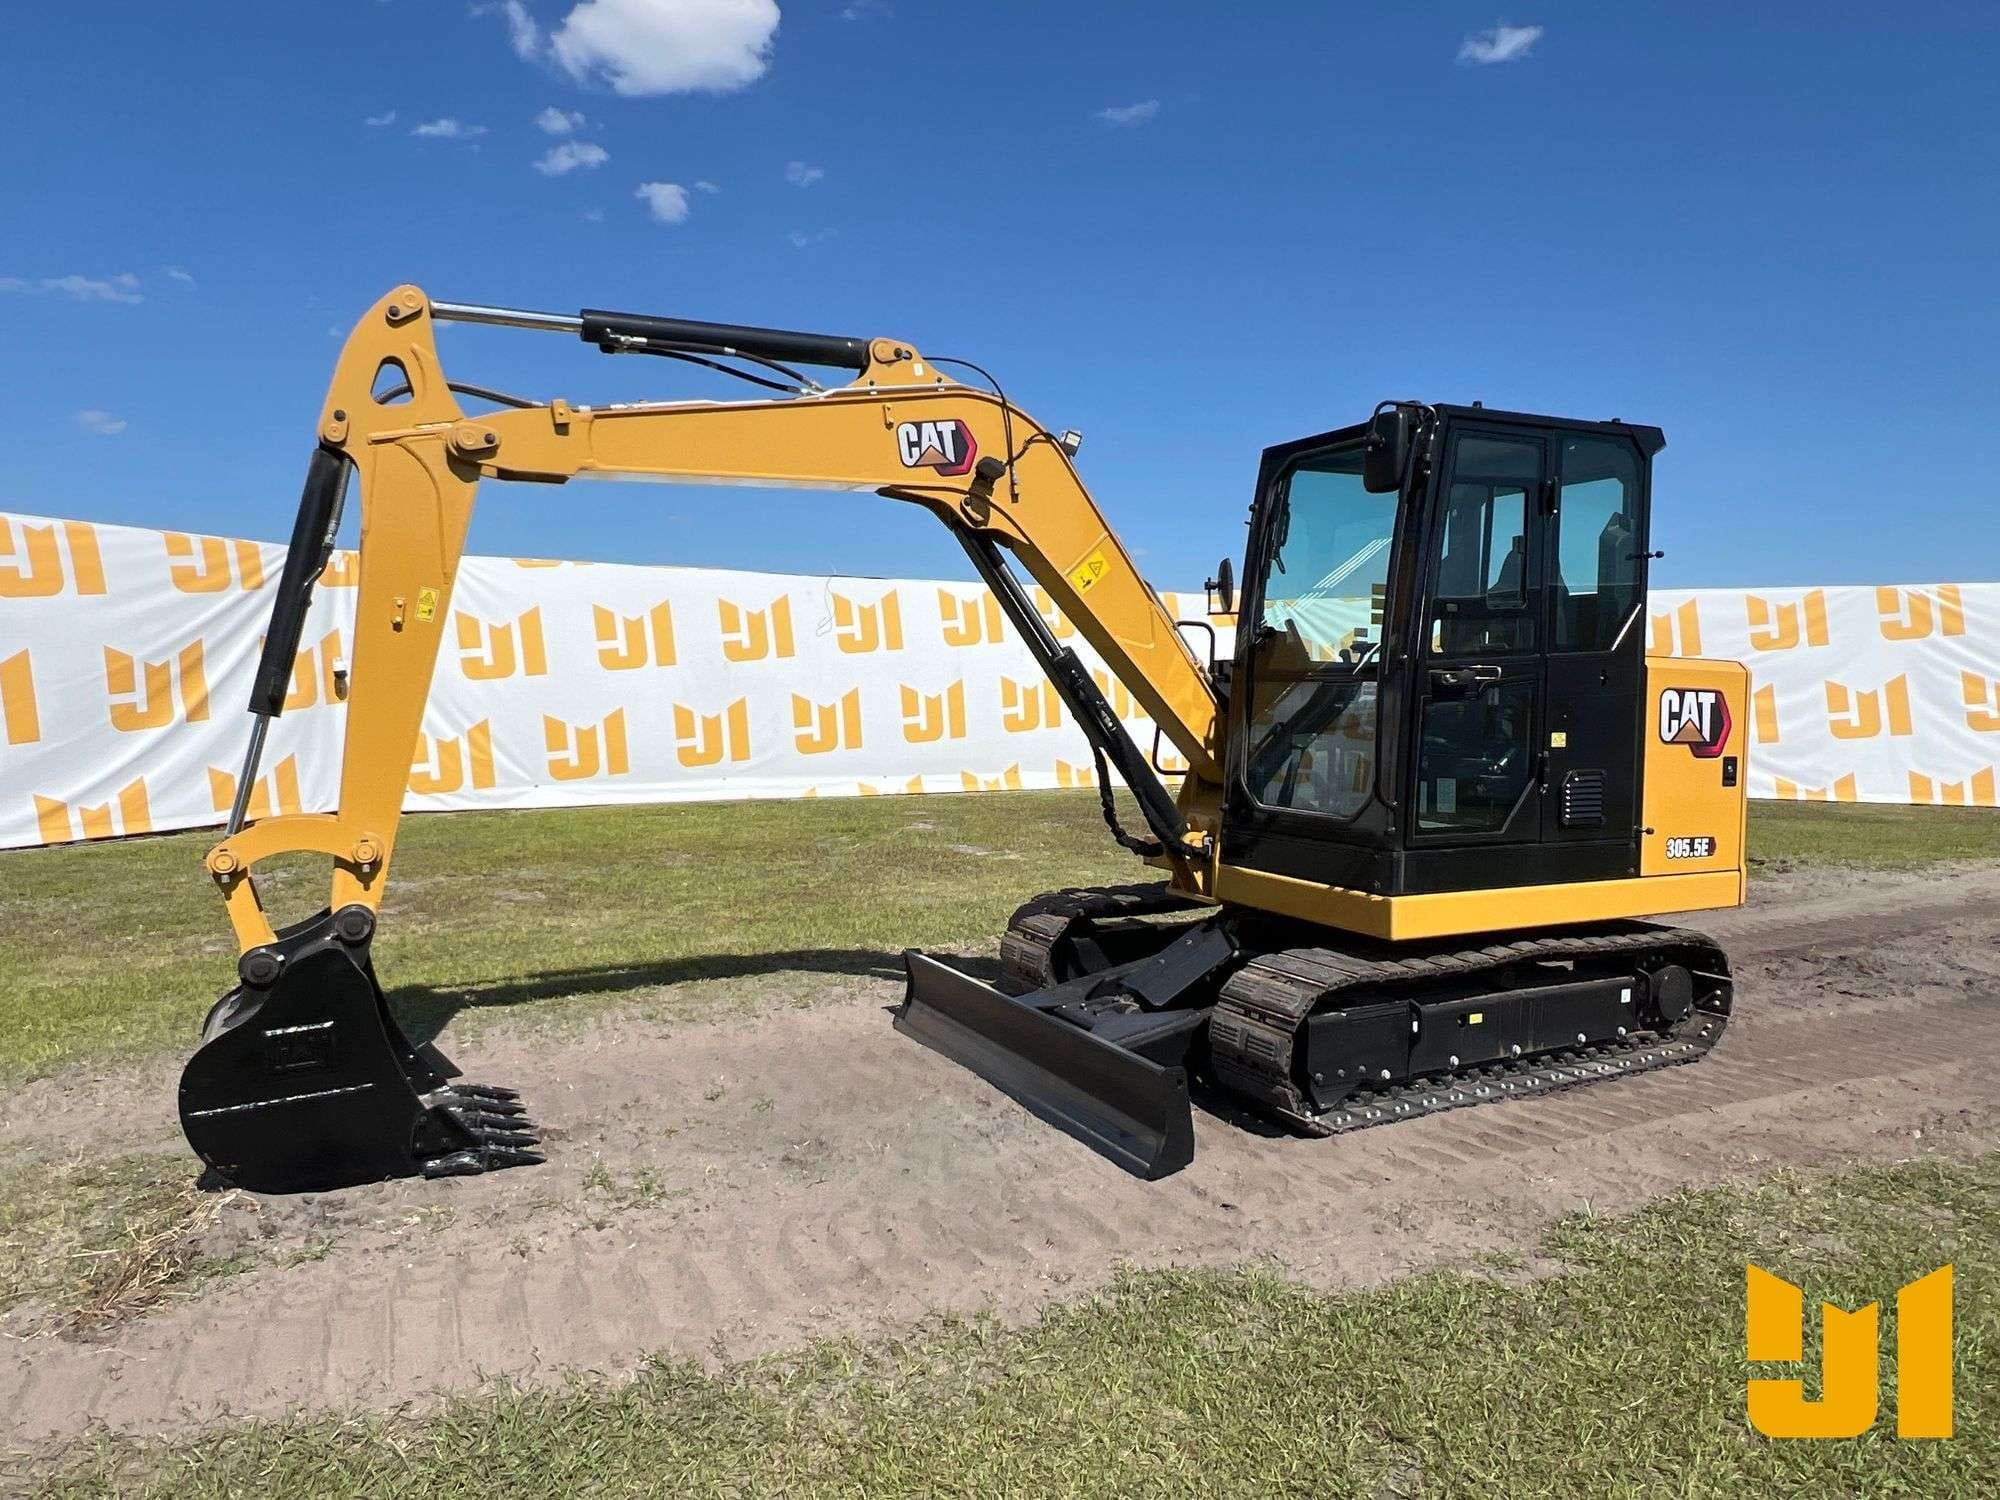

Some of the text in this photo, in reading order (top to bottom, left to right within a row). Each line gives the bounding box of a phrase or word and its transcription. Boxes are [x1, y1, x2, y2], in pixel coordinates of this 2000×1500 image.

[897, 420, 956, 467] CAT
[1661, 689, 1716, 742] CAT
[1666, 837, 1710, 859] 305.5E
